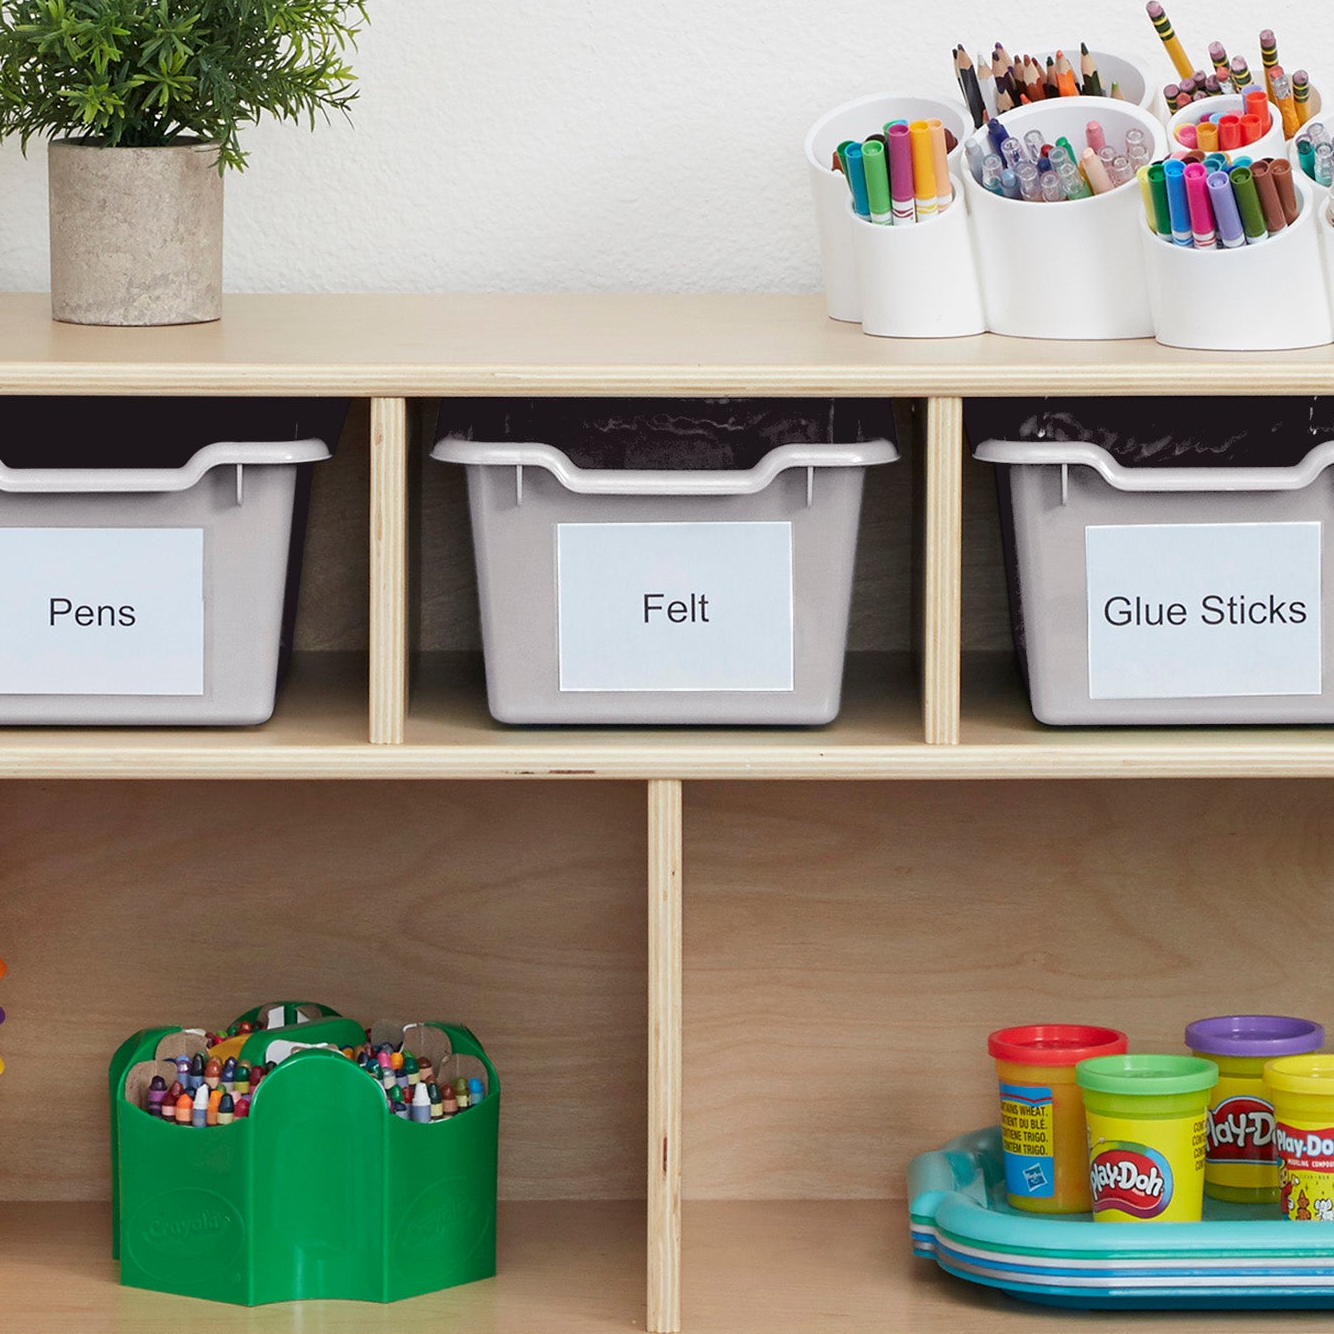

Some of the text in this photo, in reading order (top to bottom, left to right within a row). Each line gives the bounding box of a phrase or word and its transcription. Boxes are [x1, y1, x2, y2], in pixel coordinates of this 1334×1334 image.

[50, 598, 136, 627] Pens
[643, 593, 710, 623] Felt
[1104, 594, 1307, 626] Glue Sticks
[1019, 1105, 1049, 1117] WHEAT.
[1023, 1130, 1049, 1143] TRIGO.
[1023, 1143, 1049, 1156] TRIGO.
[1090, 1160, 1165, 1201] Play-Doh
